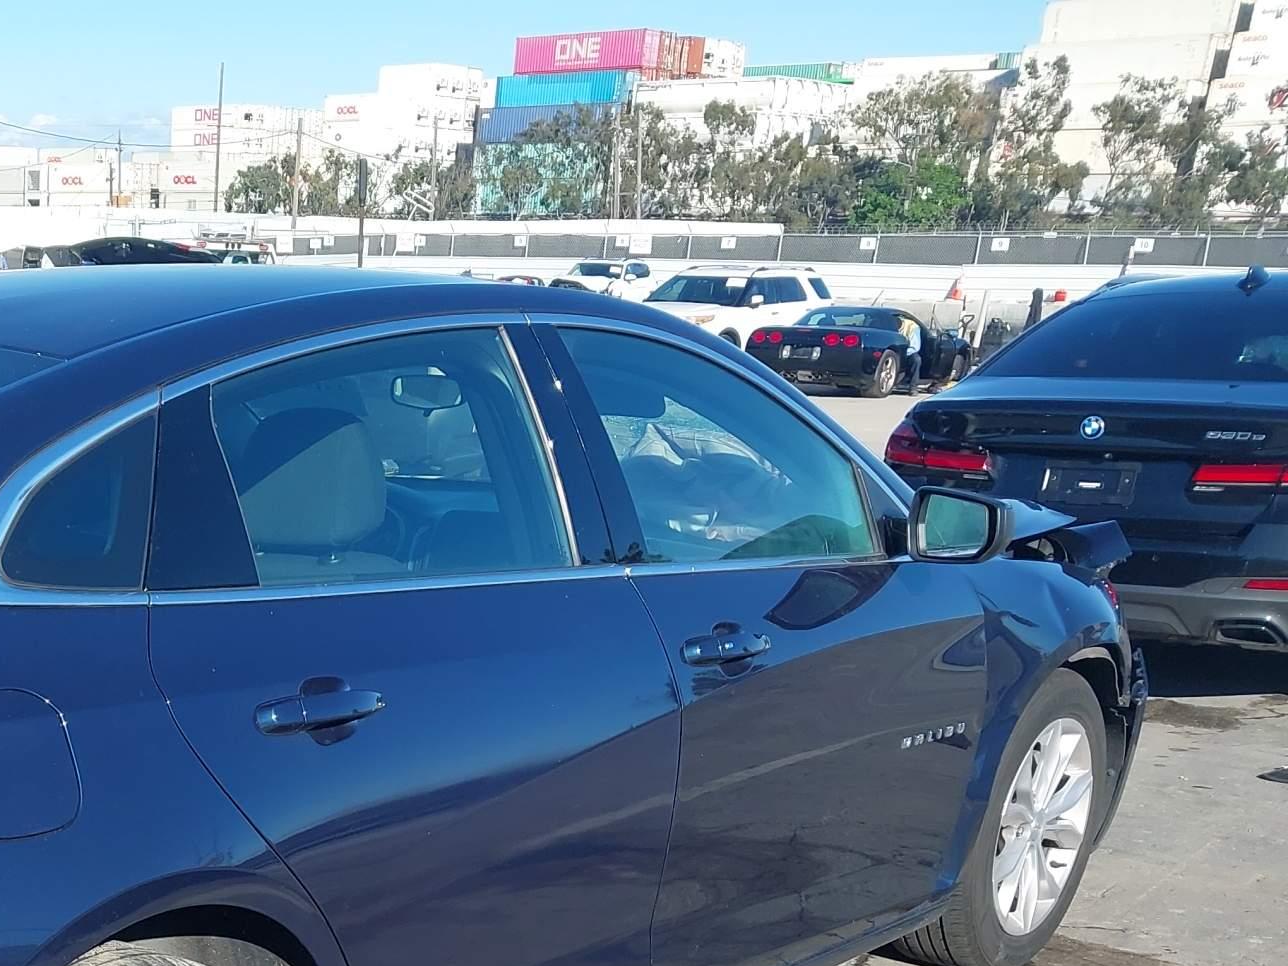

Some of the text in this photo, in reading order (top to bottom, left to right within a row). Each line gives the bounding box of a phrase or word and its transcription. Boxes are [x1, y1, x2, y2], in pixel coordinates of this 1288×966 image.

[555, 37, 601, 60] ONE
[194, 108, 219, 121] ONE
[193, 132, 218, 146] ONE
[62, 176, 84, 186] OOCL
[173, 175, 197, 185] OOCL
[1139, 241, 1149, 249] 10
[900, 722, 966, 749] MALIBU
